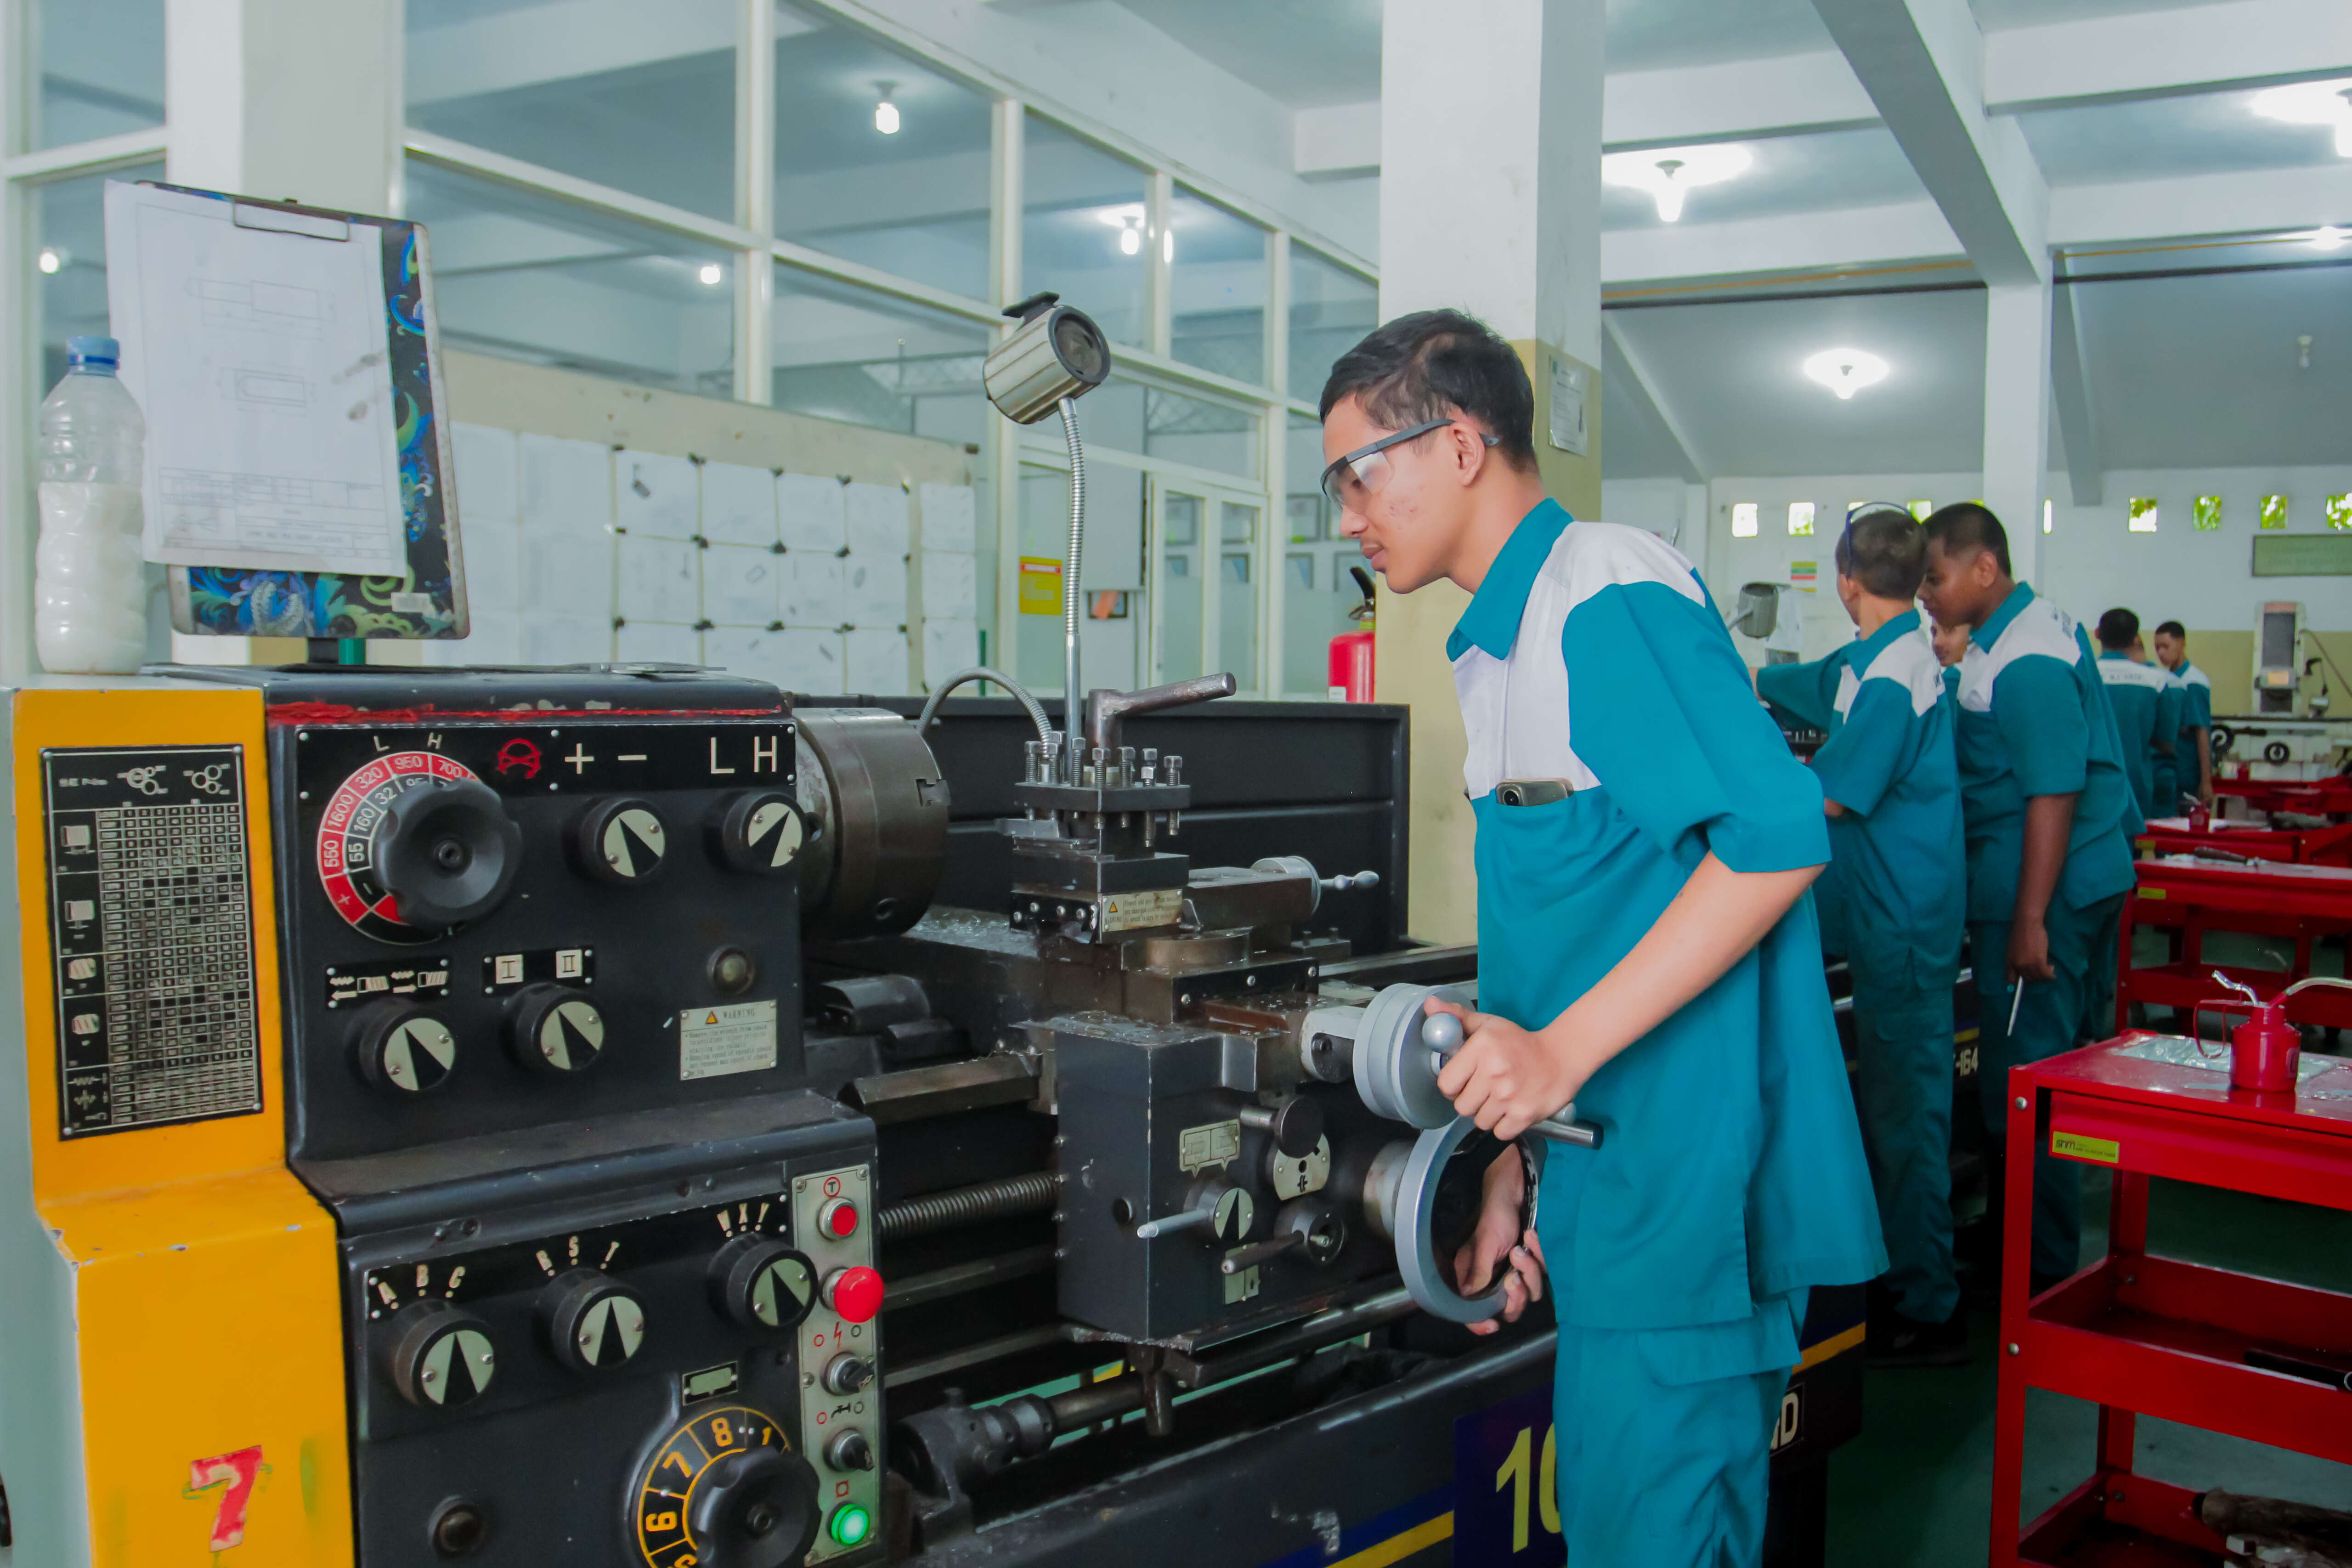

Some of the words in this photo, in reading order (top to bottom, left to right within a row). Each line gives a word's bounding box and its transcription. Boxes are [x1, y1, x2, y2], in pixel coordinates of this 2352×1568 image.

[373, 736, 390, 751] L
[427, 733, 442, 749] H
[395, 756, 423, 770] 950
[710, 737, 735, 774] L
[754, 736, 778, 772] H
[355, 767, 383, 790] 320
[438, 759, 463, 778] 700
[375, 787, 397, 805] 32
[328, 794, 354, 827] 1600
[353, 809, 375, 832] 160
[323, 840, 340, 867] 550
[348, 843, 364, 862] 55
[826, 1181, 837, 1193] T
[569, 1236, 579, 1258] S
[416, 1265, 428, 1287] B
[448, 1266, 465, 1288] C
[1770, 1393, 1799, 1450] D
[645, 1511, 678, 1533] 6
[662, 1451, 692, 1478] 7
[712, 1417, 733, 1447] 8
[762, 1426, 772, 1446] 1
[190, 1445, 263, 1553] 7
